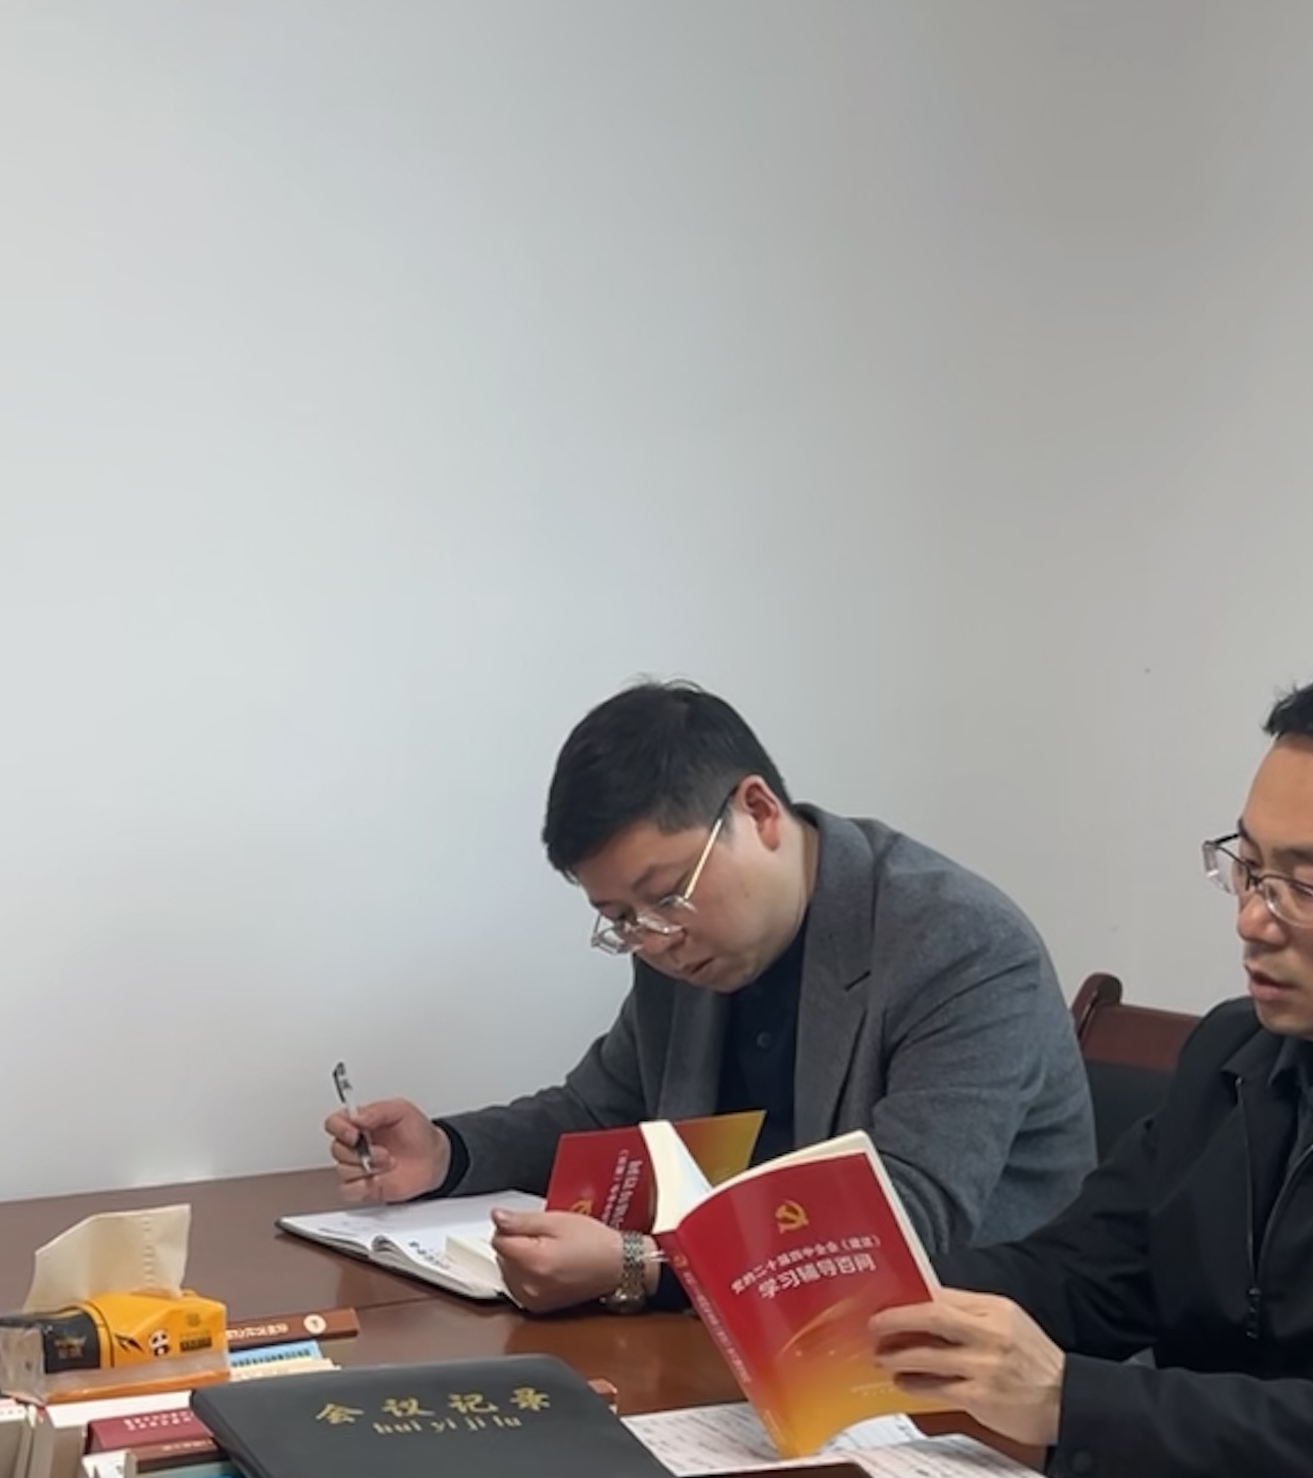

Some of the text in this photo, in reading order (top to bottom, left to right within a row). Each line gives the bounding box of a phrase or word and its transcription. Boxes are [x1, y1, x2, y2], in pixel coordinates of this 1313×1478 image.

[758, 1253, 876, 1299] 学习辅导百问
[316, 1387, 550, 1424] 会议记录
